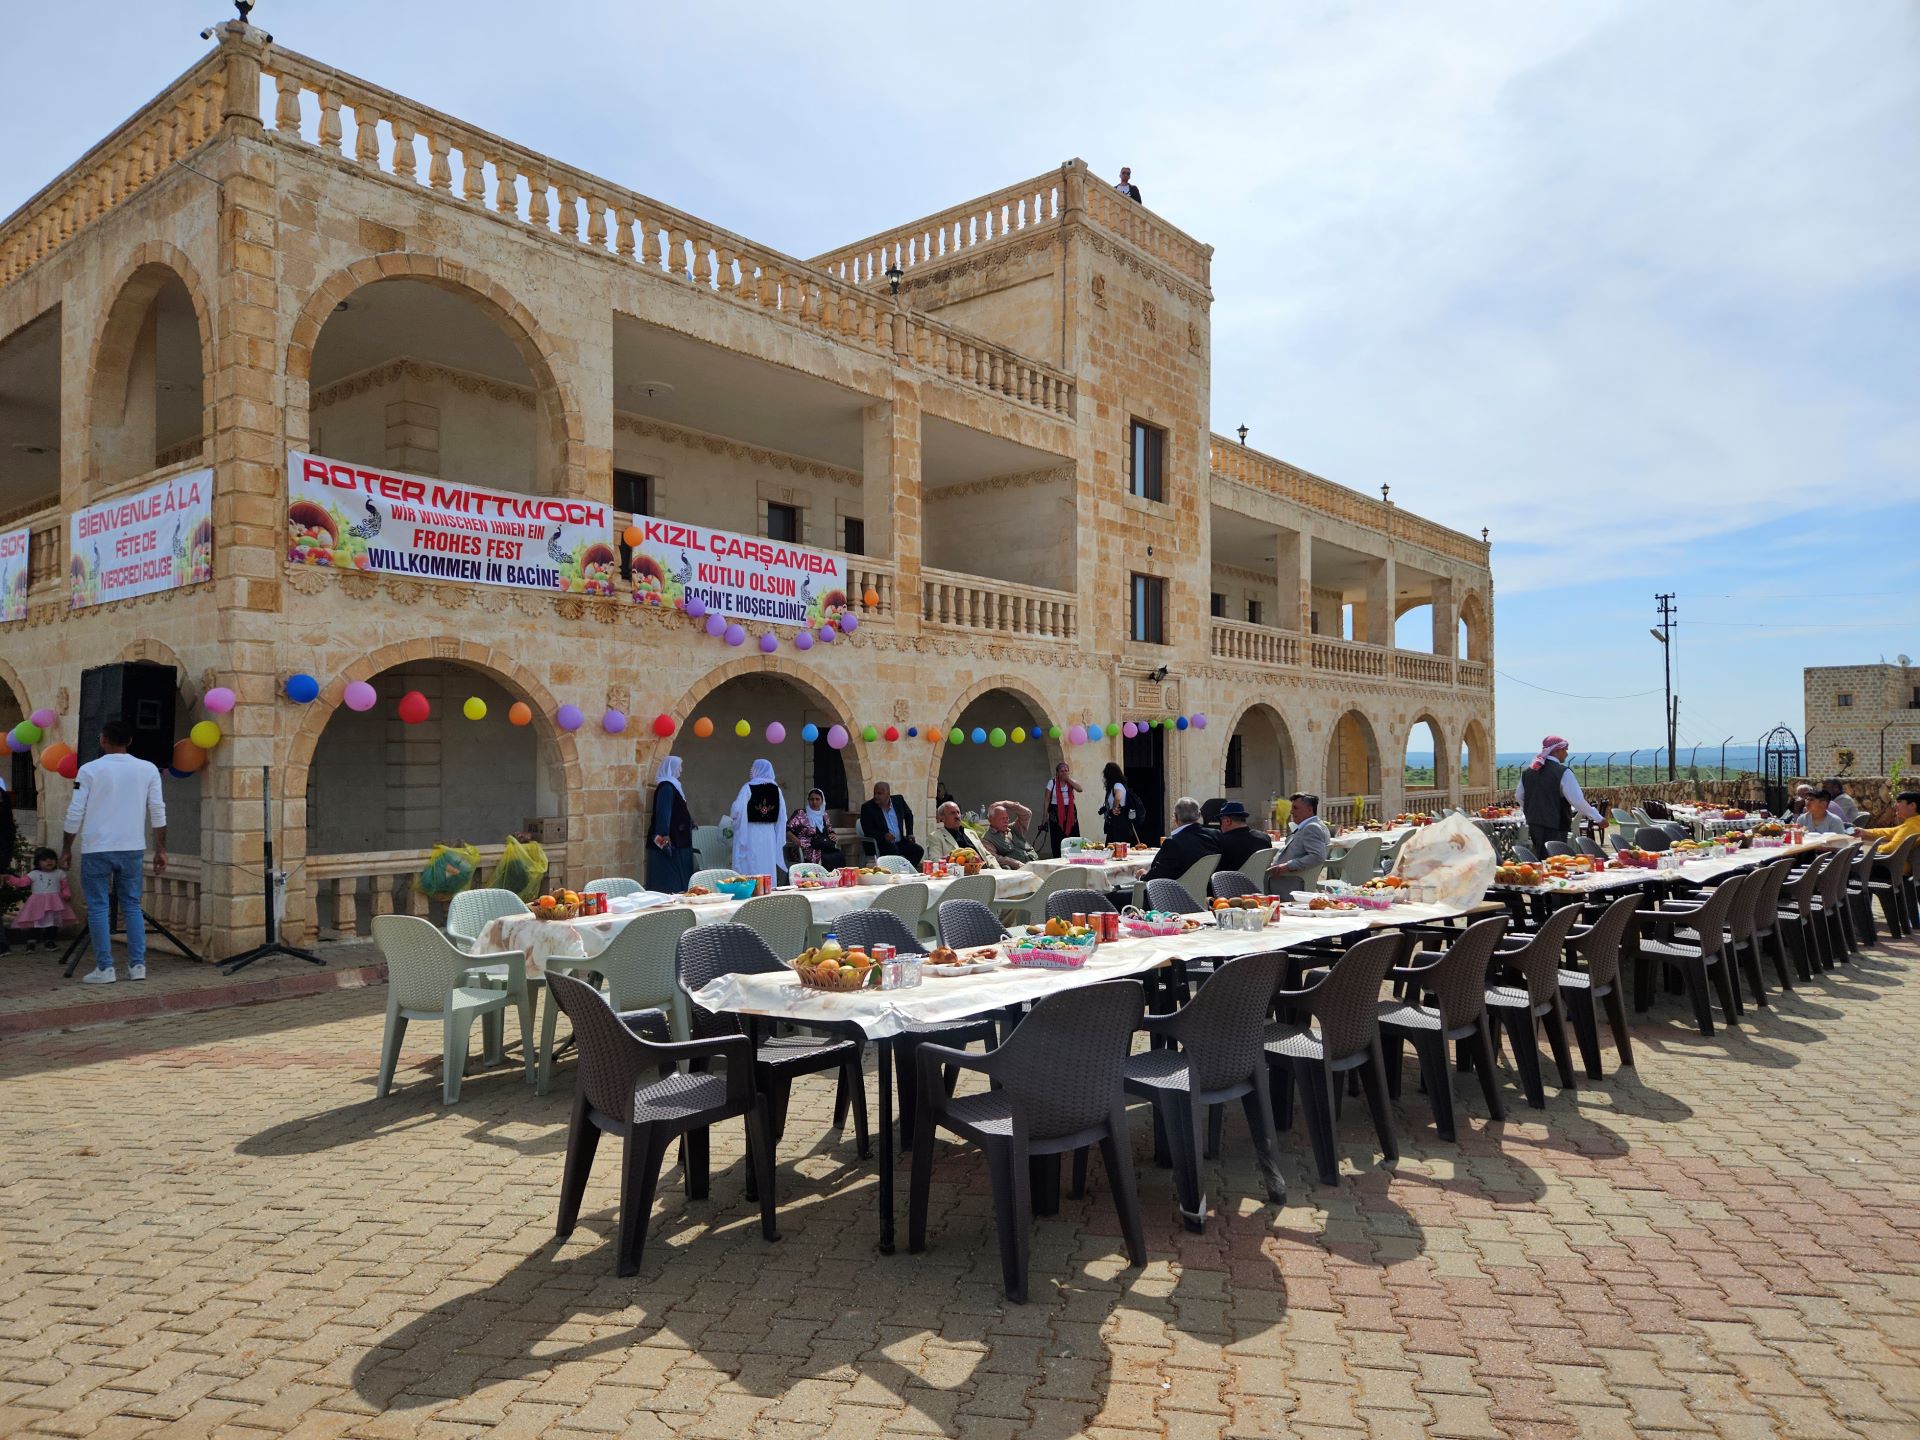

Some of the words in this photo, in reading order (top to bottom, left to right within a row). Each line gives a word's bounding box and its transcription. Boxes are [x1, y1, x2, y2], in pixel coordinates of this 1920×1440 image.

[178, 482, 201, 510] LA
[303, 459, 426, 505] ROTER
[431, 486, 604, 528] MITTWOCH
[142, 530, 157, 553] DE
[413, 529, 482, 555] FROHES
[486, 538, 524, 561] FEST
[490, 520, 525, 538] IHNEN
[528, 523, 545, 540] EIN
[367, 547, 481, 581] WILLKOMMEN
[644, 521, 705, 551] KIZIL
[710, 535, 837, 577] ÇARŞAMBA
[143, 555, 173, 582] ROUGE
[698, 562, 745, 589] KUTLU
[749, 572, 796, 598] OLSUN
[735, 594, 807, 622] HOŞGELDİNİZ
